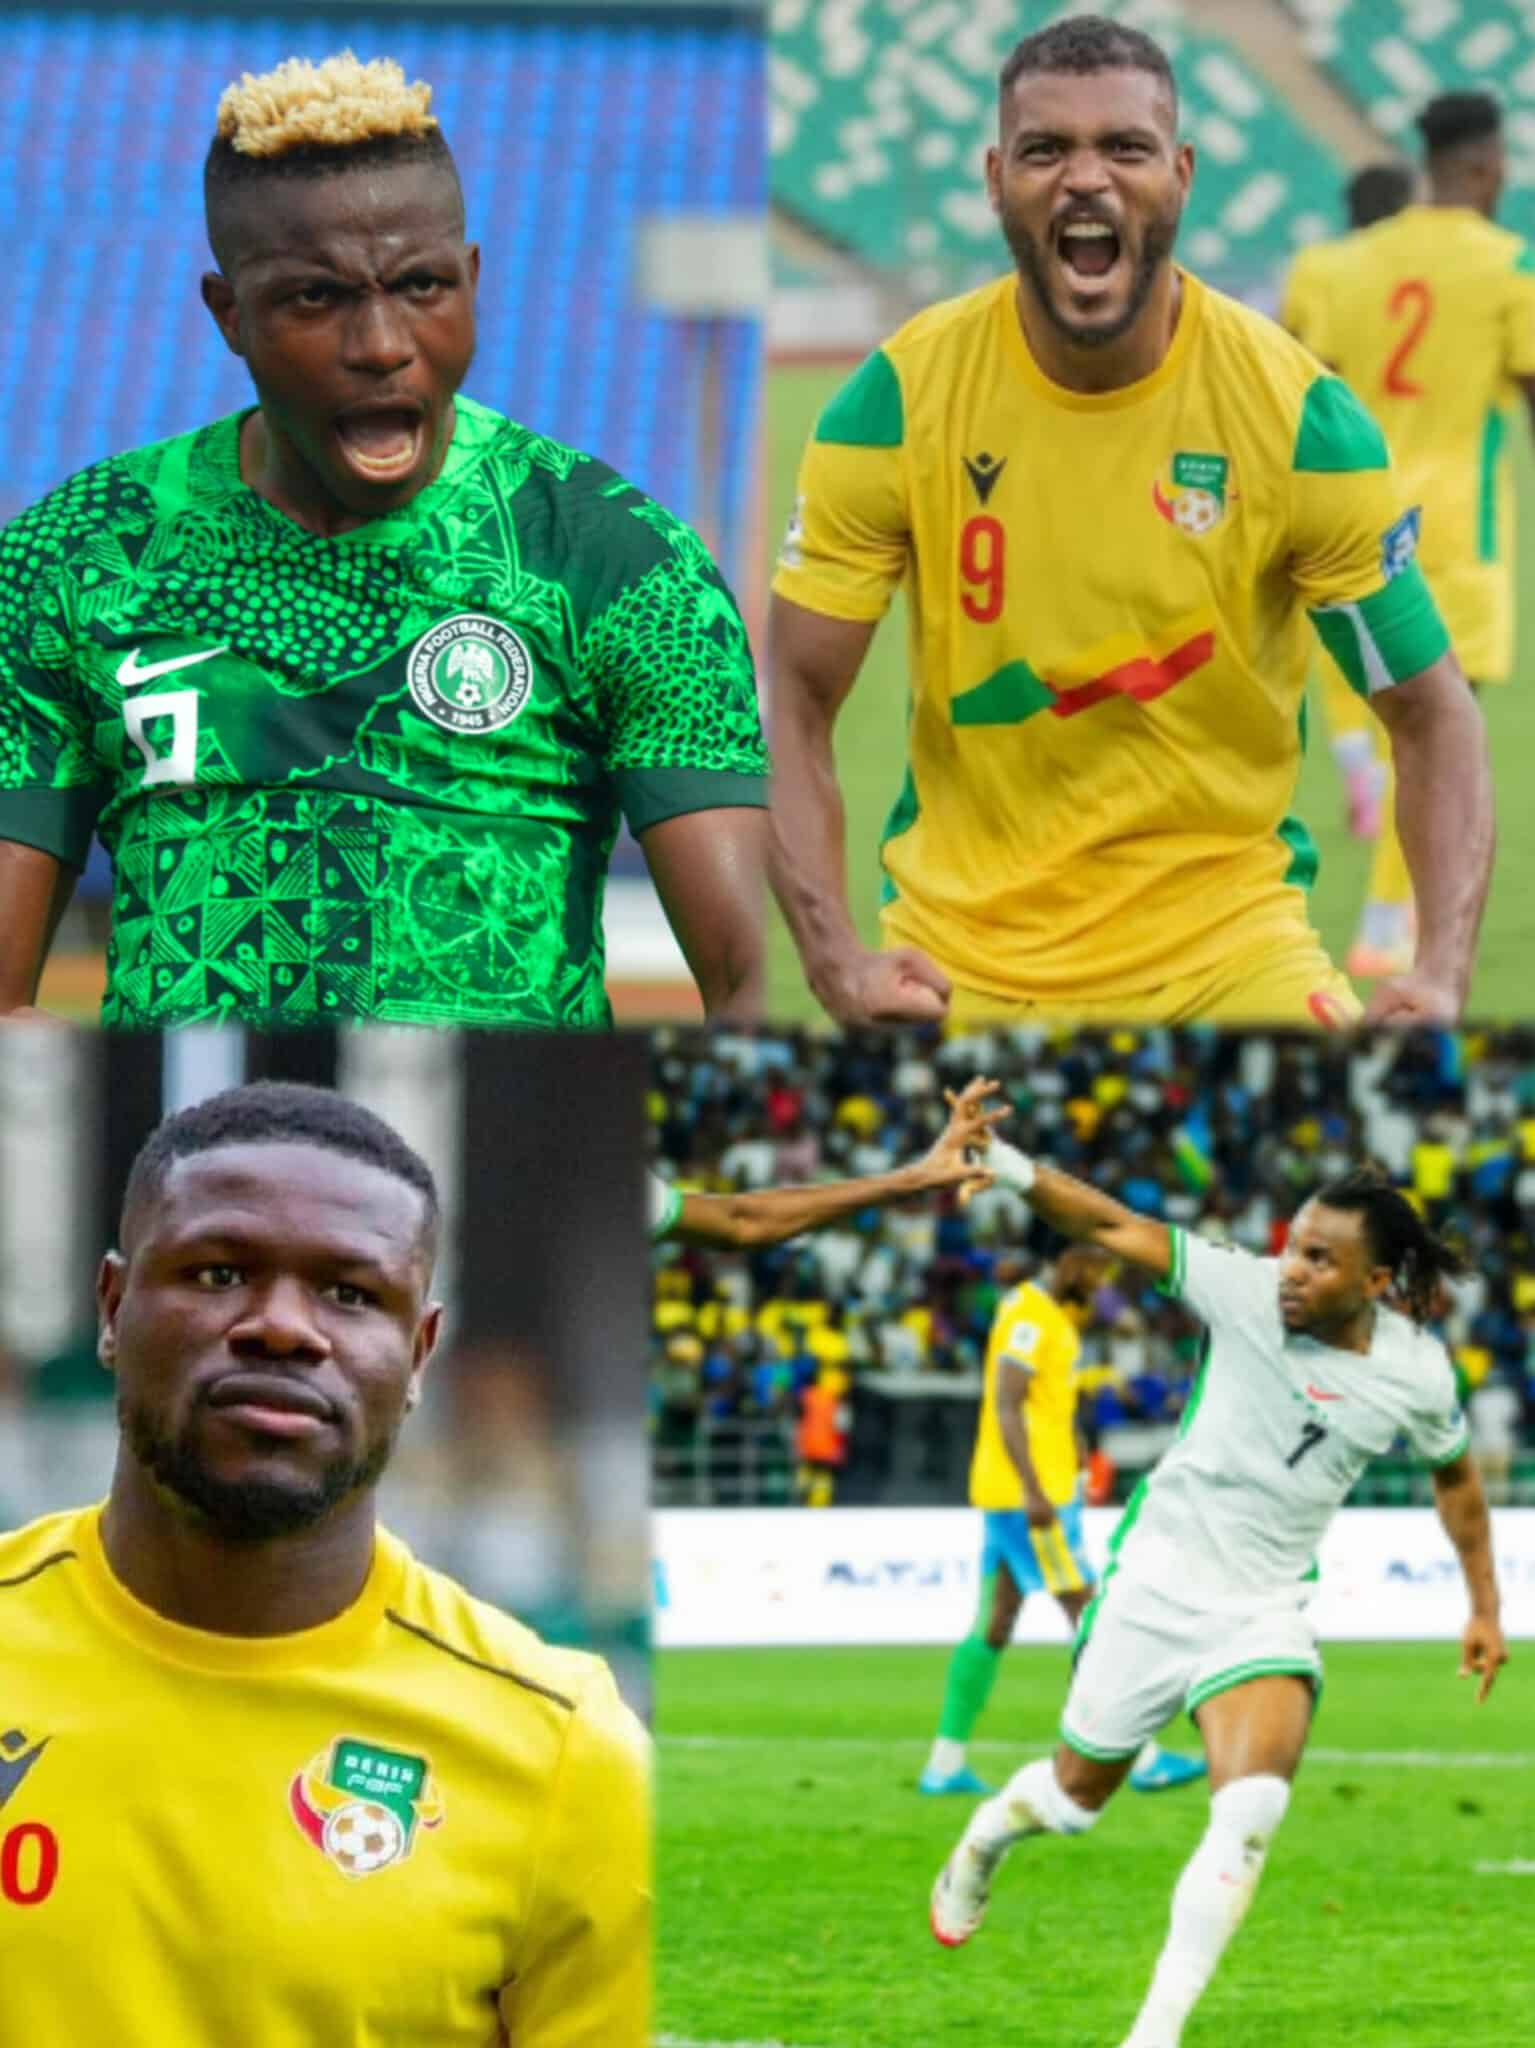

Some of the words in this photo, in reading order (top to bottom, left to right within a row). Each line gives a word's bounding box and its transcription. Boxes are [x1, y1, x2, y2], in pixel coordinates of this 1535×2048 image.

[1382, 284, 1431, 397] 2
[959, 515, 1005, 624] 9
[425, 621, 497, 654] FOOTBALL
[413, 654, 438, 706] NIGERIA
[497, 633, 527, 716] FEDERATION
[452, 711, 484, 727] 1945
[1285, 1423, 1328, 1469] 7
